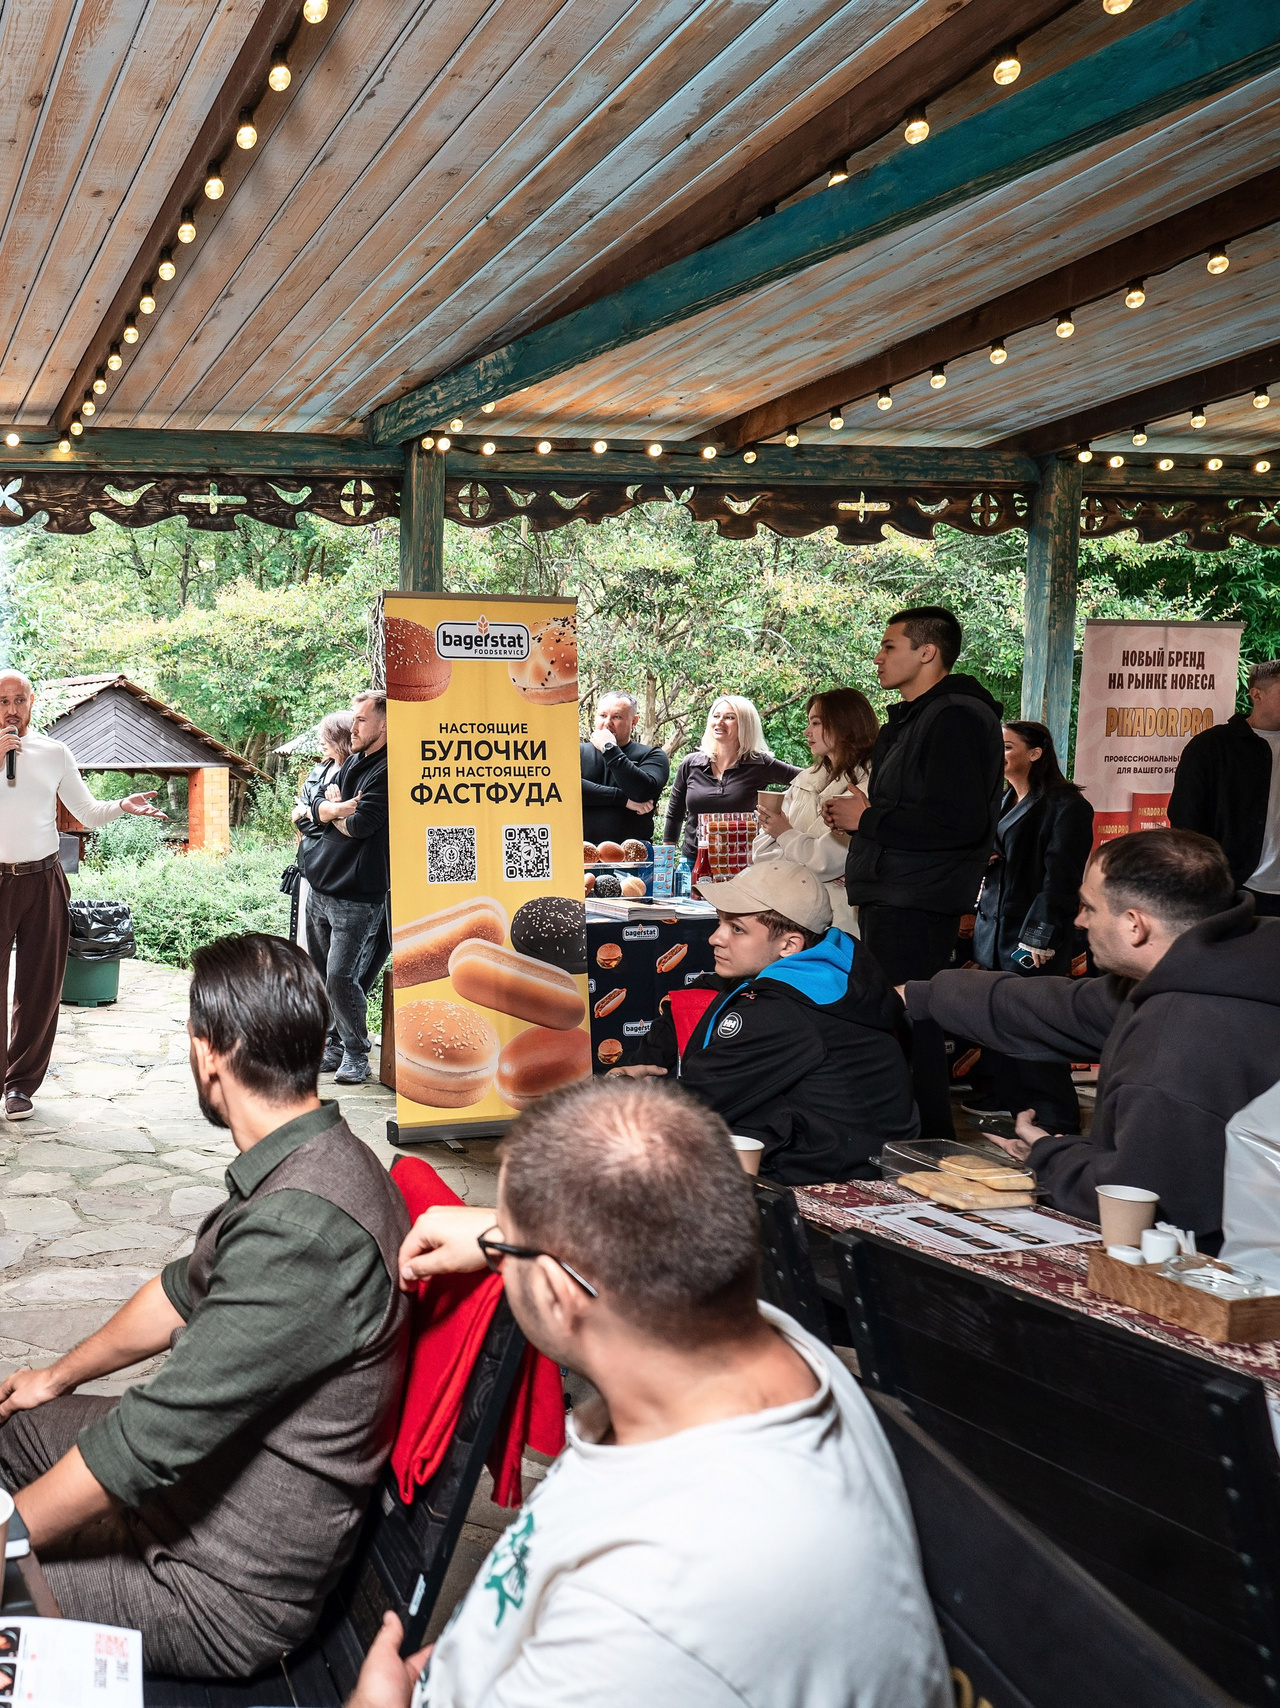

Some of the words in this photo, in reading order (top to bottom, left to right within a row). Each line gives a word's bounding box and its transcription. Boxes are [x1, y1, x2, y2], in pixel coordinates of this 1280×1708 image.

[442, 631, 524, 650] bagerstat
[1122, 647, 1165, 667] НОВЫЙ
[1167, 650, 1205, 670] БРЕНД
[1108, 673, 1124, 690] НА
[1127, 673, 1168, 690] РЫНКЕ
[1170, 673, 1216, 690] HORECA
[438, 722, 528, 735] НАСТОЯЩИЕ
[1105, 707, 1179, 738] PIKADOR
[1179, 707, 1214, 738] PRO
[420, 740, 547, 761] БУЛОЧКИ
[1104, 755, 1180, 763] ПРОФЕССИОНАЛЬНЫ
[421, 766, 451, 779] ДЛЯ
[455, 766, 551, 779] НАСТОЯЩЕГО
[1116, 766, 1132, 775] ДЛЯ
[1133, 766, 1163, 774] ВАШЕГО
[410, 782, 563, 806] ФАСТФУДА
[625, 929, 656, 938] bagerstat
[625, 1025, 651, 1033] bagerst
